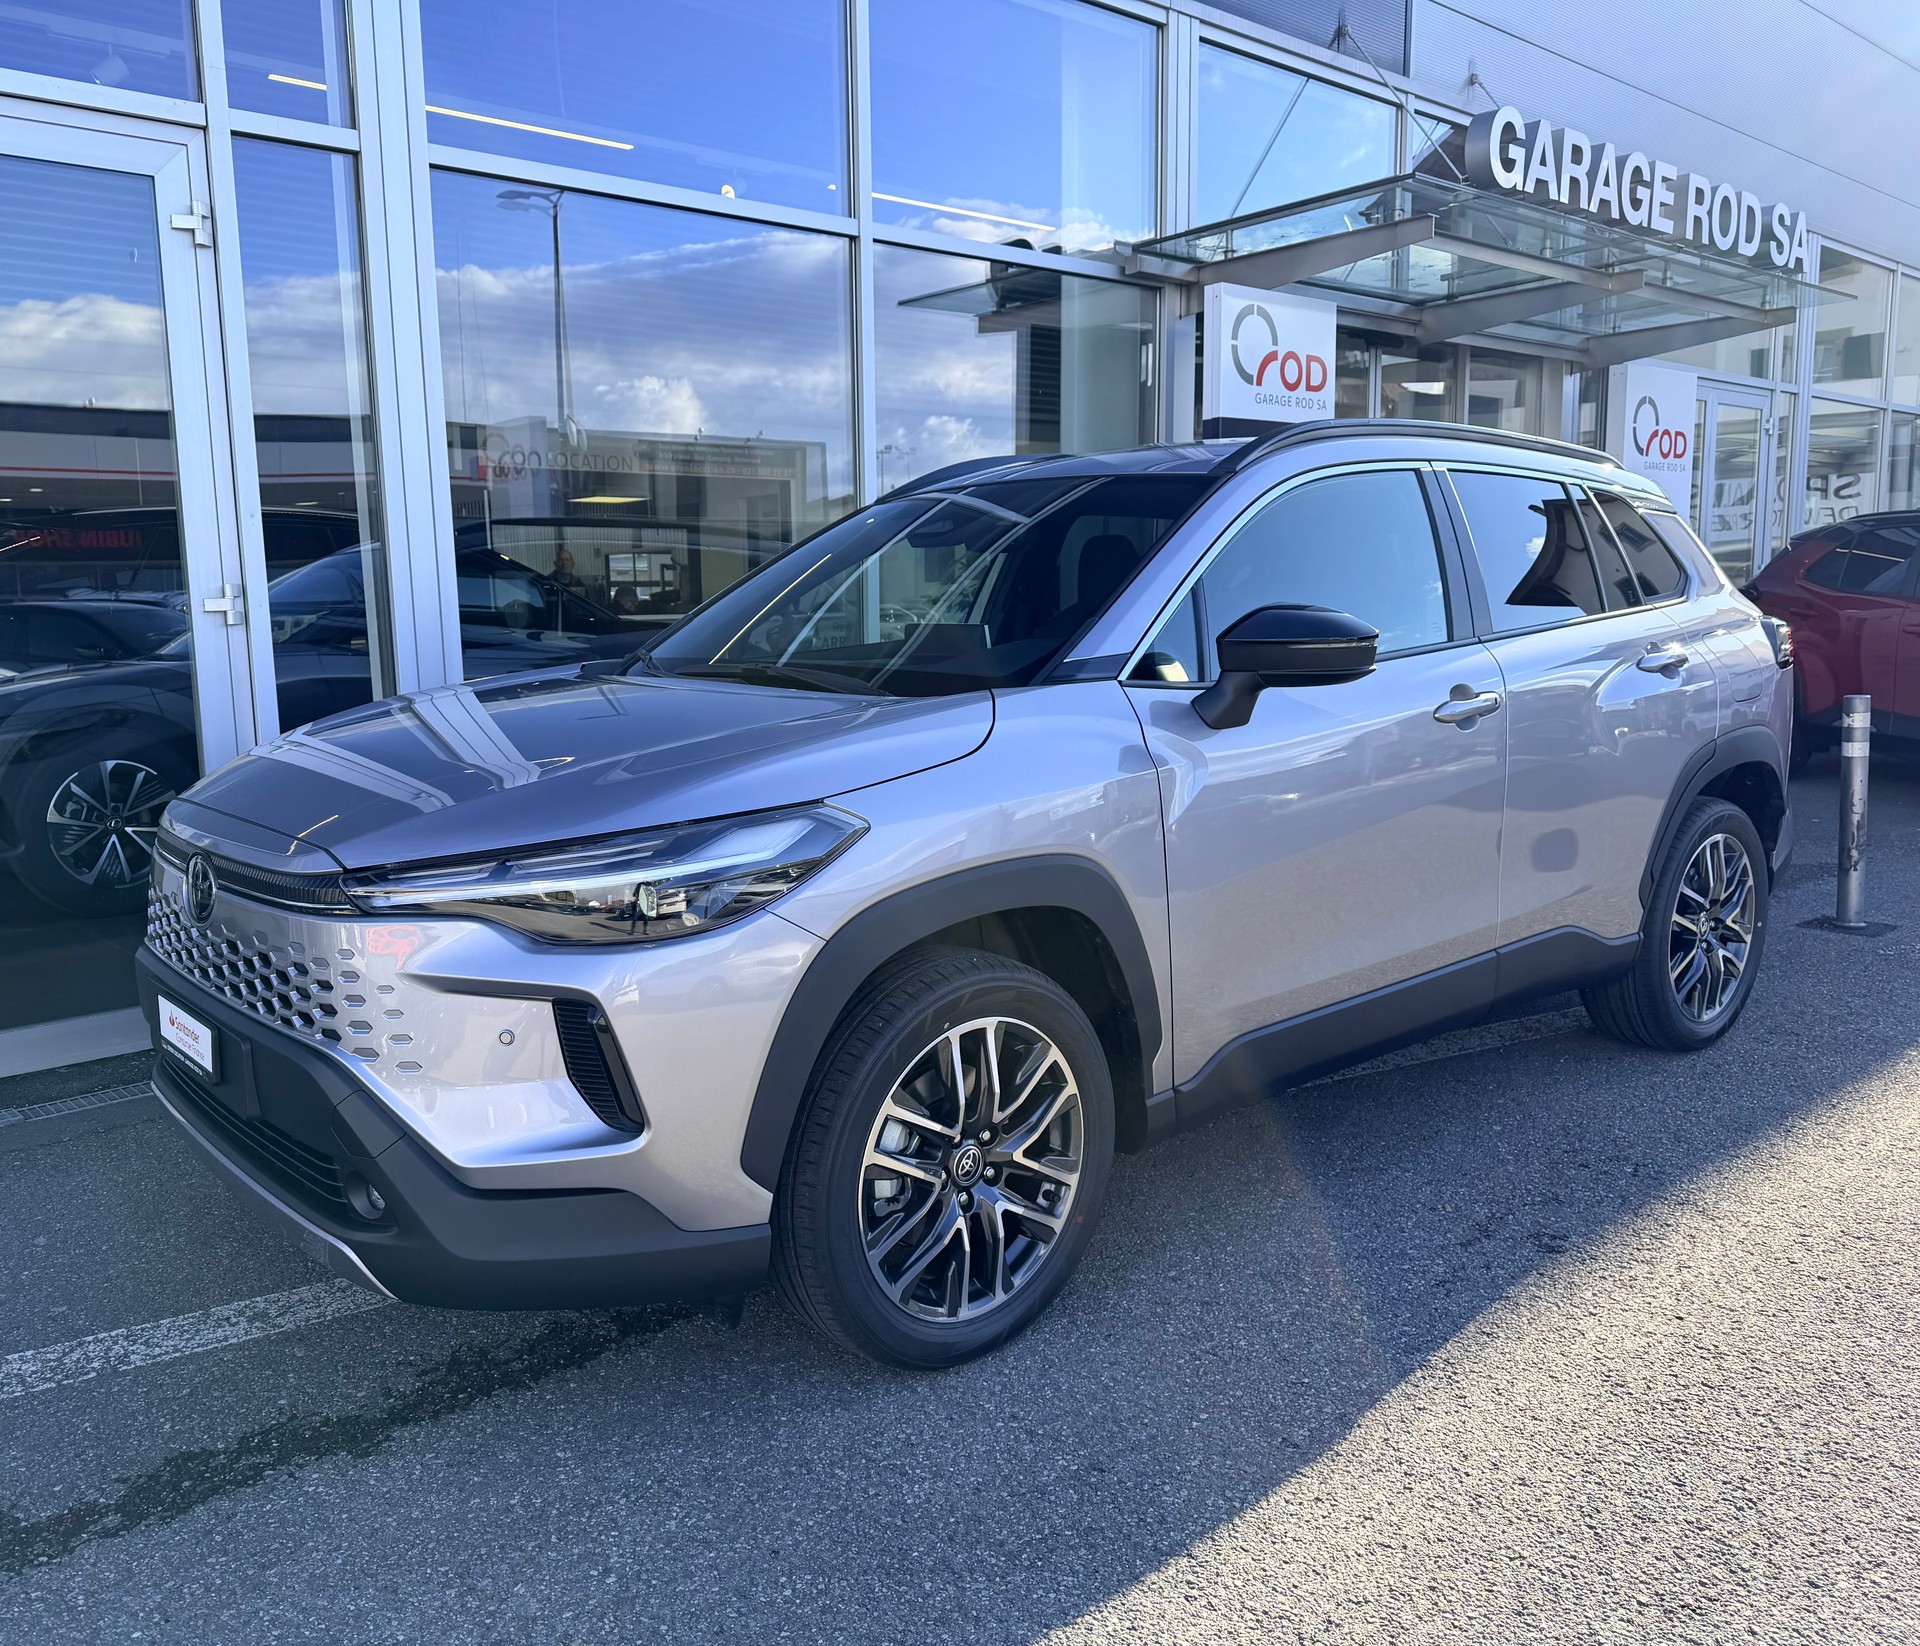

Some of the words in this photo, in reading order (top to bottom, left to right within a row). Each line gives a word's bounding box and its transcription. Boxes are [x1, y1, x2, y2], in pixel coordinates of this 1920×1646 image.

[1490, 105, 1678, 235] GARAGE
[1686, 172, 1762, 257] ROD
[1770, 202, 1809, 273] SA
[1254, 392, 1292, 408] GARAGE
[1295, 396, 1314, 410] ROD
[1316, 398, 1327, 411] SA
[546, 450, 633, 472] LOCATION
[1643, 461, 1665, 472] GARAGE
[1666, 463, 1678, 472] ROD
[1679, 464, 1686, 472] SA
[175, 1016, 200, 1045] Santander
